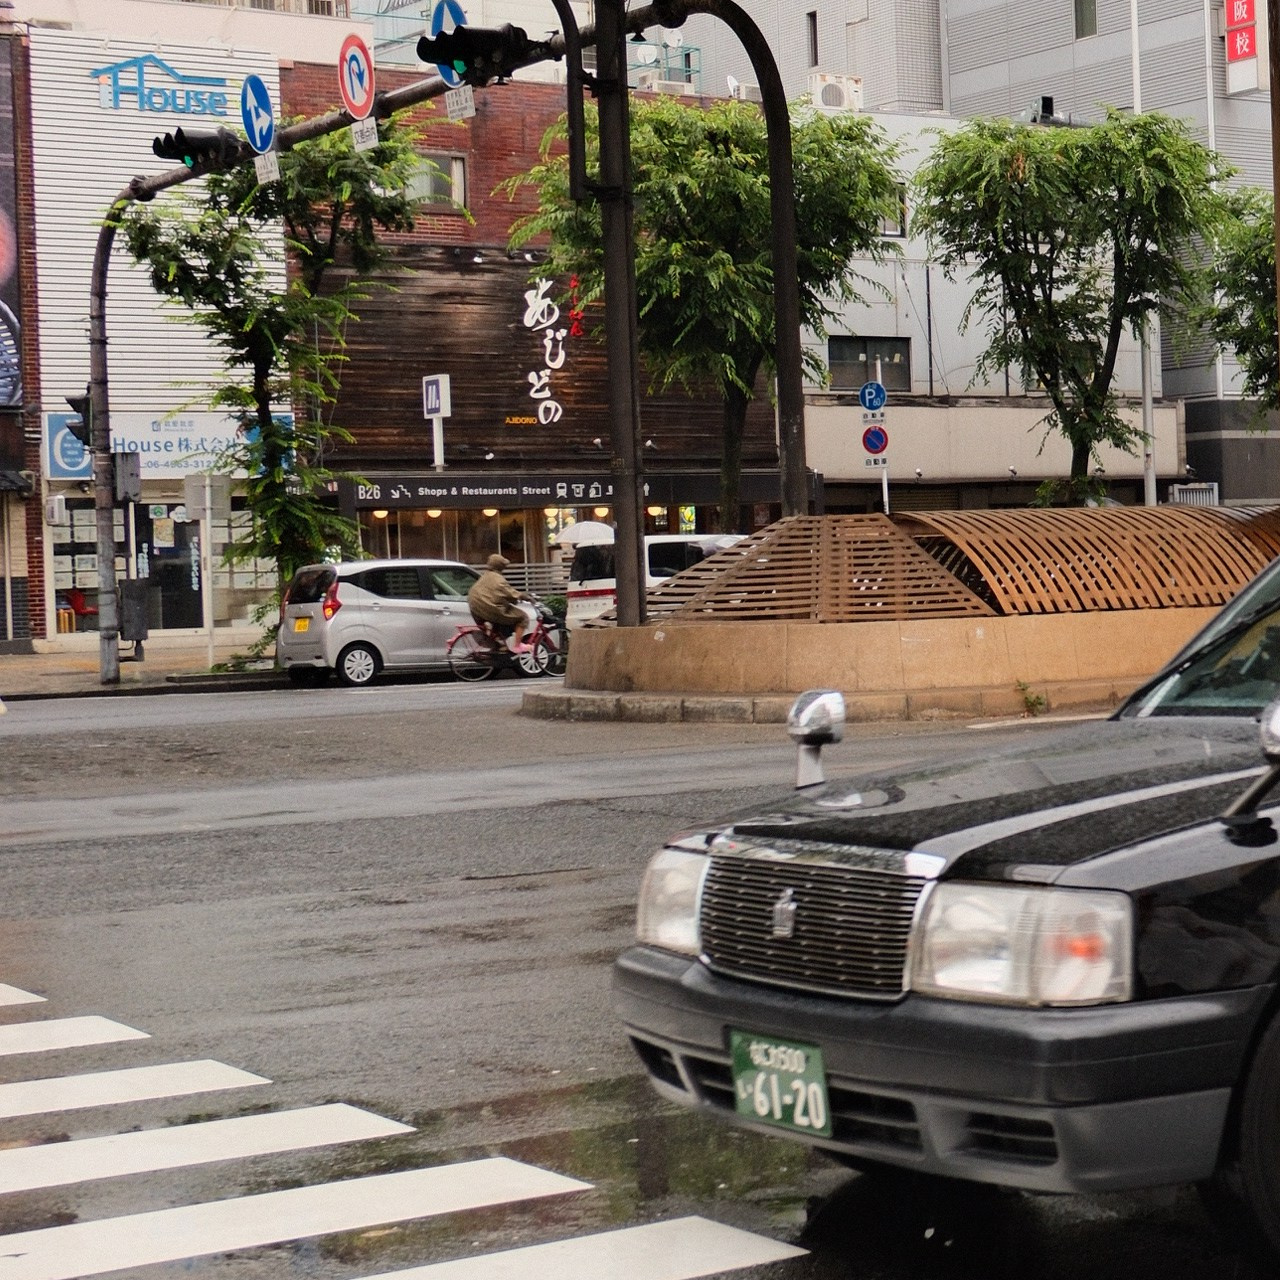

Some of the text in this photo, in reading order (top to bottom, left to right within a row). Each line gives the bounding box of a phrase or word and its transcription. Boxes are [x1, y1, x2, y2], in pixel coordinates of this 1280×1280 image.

[523, 277, 563, 425] あじどの
[358, 485, 551, 499] B26 Shops & Restaurants Street
[754, 1072, 826, 1129] 61-20
